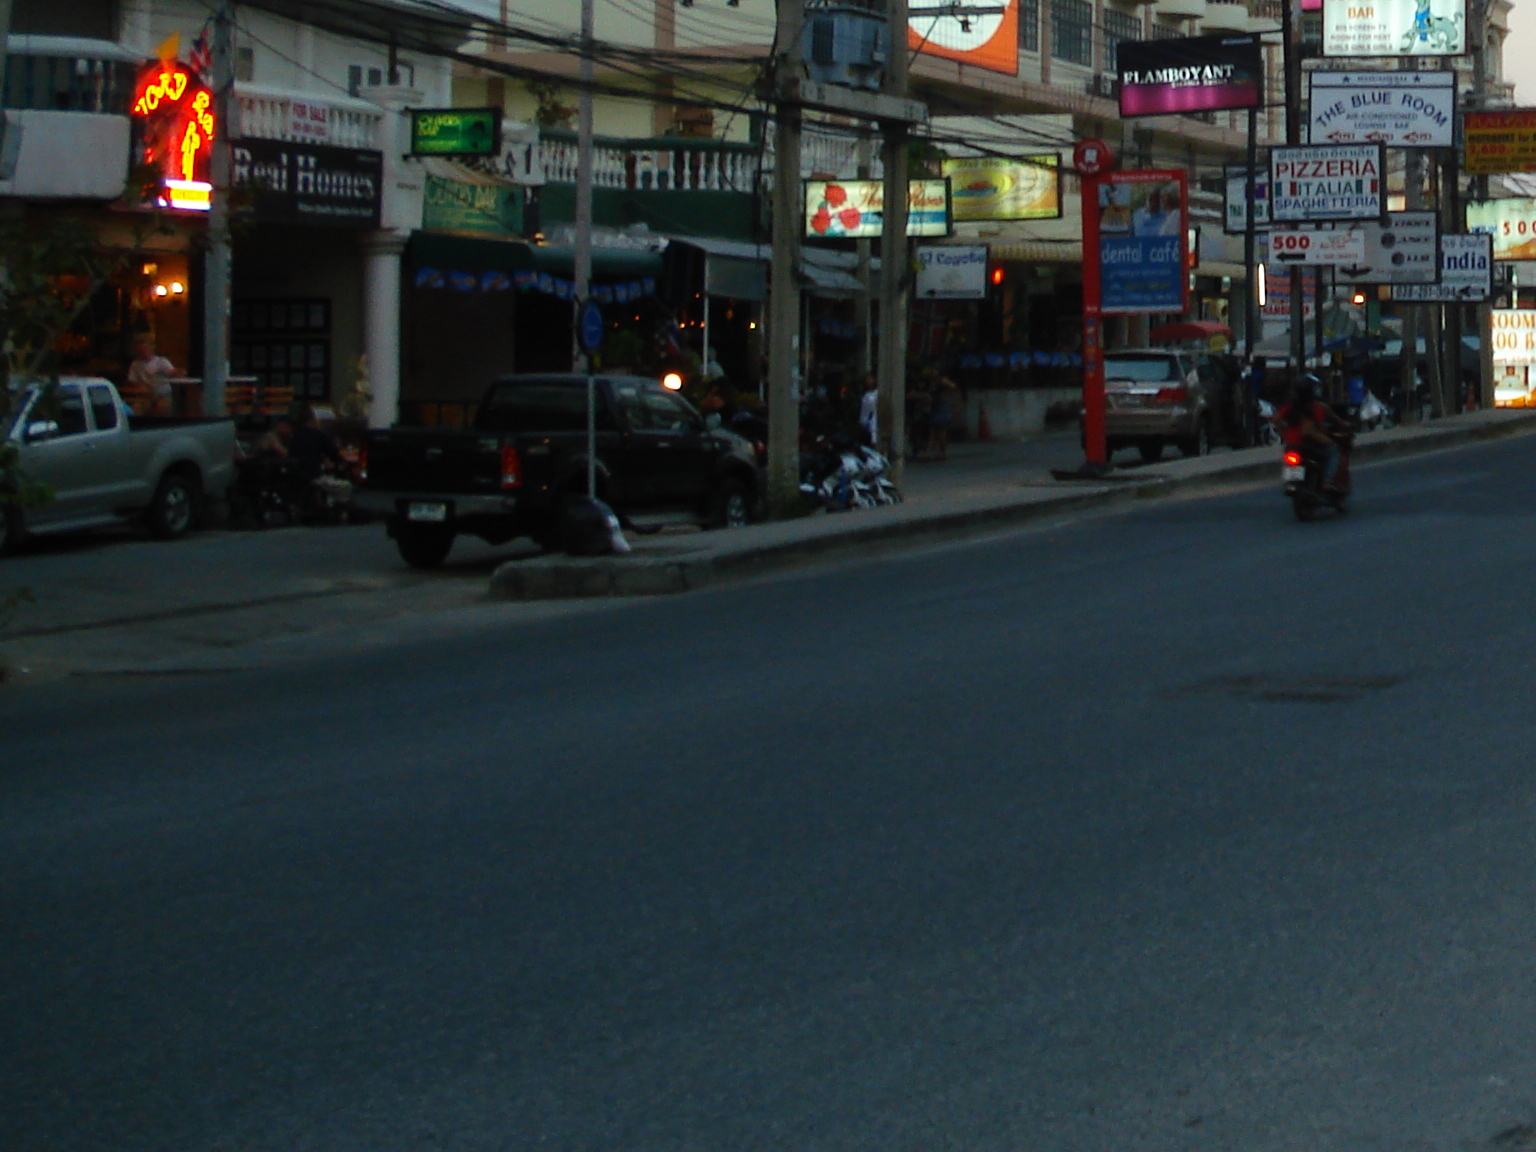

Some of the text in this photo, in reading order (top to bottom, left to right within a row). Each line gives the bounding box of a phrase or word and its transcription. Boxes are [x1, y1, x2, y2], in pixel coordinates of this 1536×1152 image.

[1347, 7, 1374, 19] BAR
[1123, 63, 1235, 86] FLAMBOYANT
[1315, 100, 1347, 128] THE
[1351, 91, 1393, 109] BLUE
[1401, 92, 1449, 128] ROOM
[297, 154, 374, 198] Homes
[1276, 159, 1376, 179] PIZZERIA
[1298, 181, 1354, 196] ITALIA
[1275, 197, 1379, 211] SPAGHETTERIA
[1101, 240, 1180, 264] dental café
[1273, 235, 1311, 250] 500
[1441, 251, 1487, 270] India
[1492, 332, 1518, 349] 00
